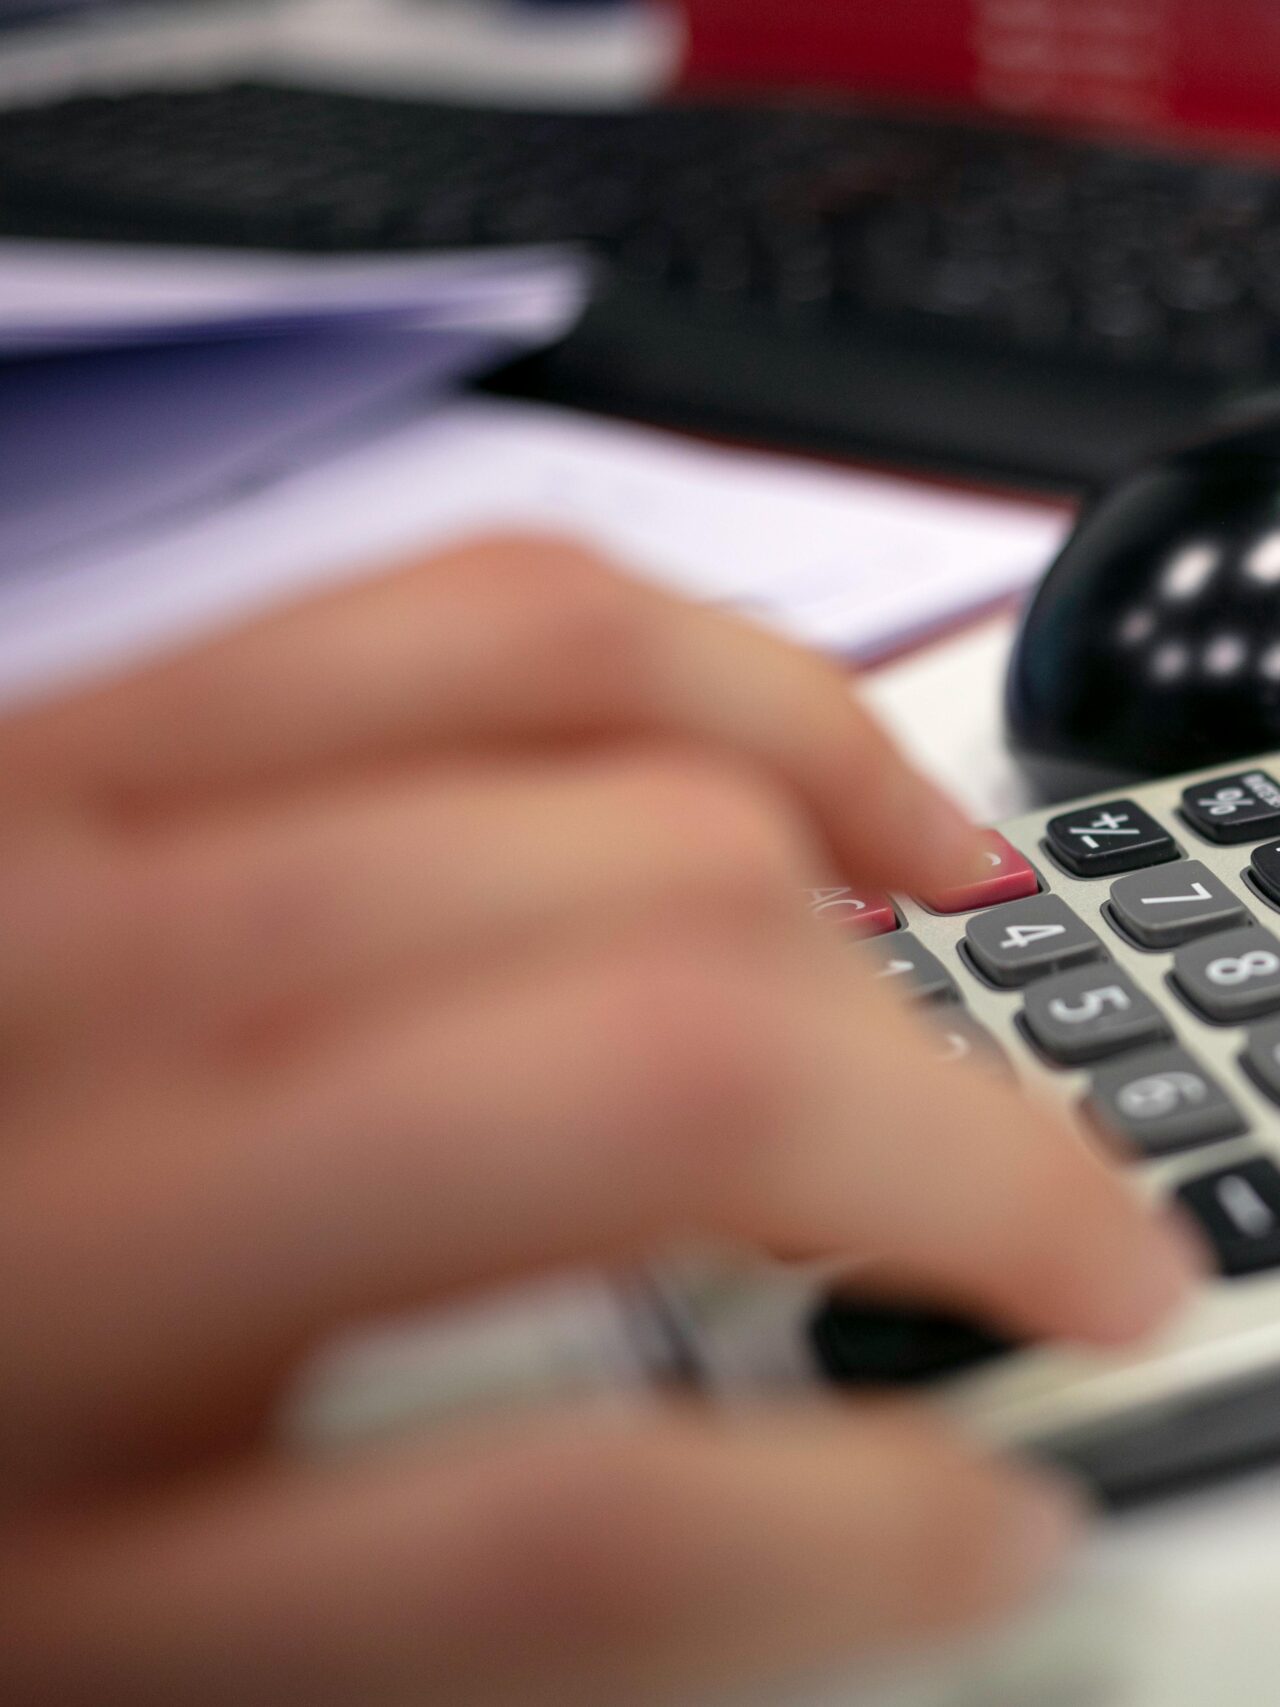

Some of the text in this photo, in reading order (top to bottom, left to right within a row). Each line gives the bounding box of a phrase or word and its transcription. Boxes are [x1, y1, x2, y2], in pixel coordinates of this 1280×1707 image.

[1197, 787, 1255, 816] %
[1140, 882, 1213, 905] 7
[999, 923, 1065, 949] 4
[1205, 950, 1280, 986] 8
[1049, 984, 1131, 1024] 5
[1117, 1070, 1208, 1119] 6
